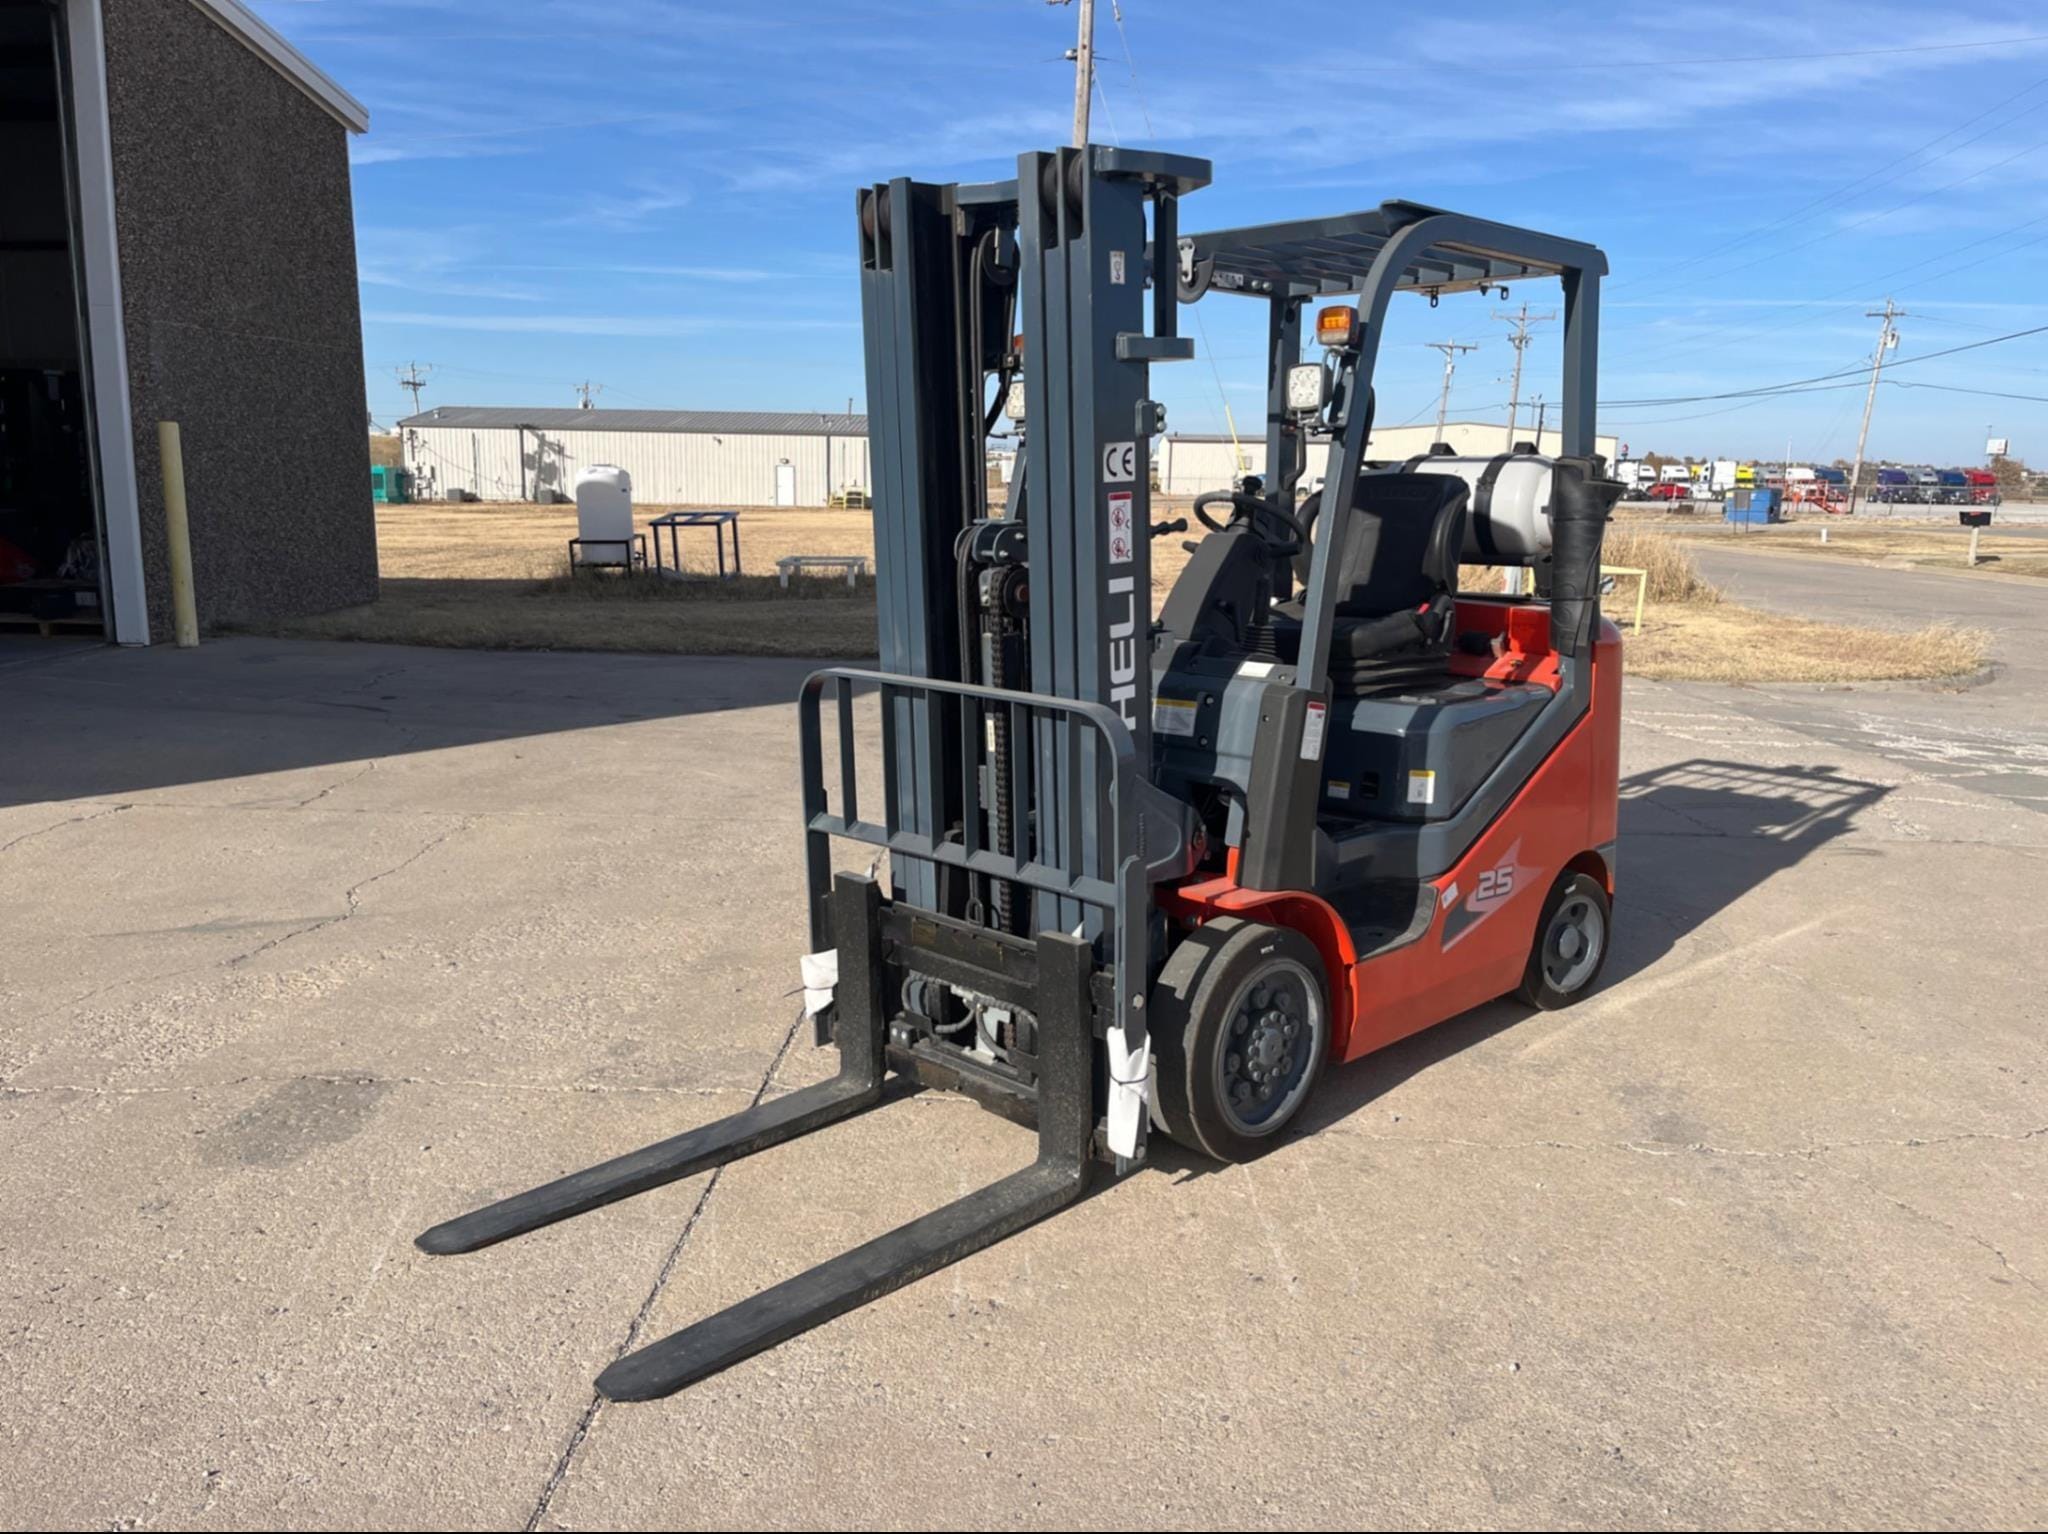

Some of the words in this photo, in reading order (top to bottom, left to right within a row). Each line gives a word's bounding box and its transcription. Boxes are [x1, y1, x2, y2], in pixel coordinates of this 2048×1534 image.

[1106, 446, 1133, 477] CE
[1108, 577, 1136, 731] HELI
[1477, 866, 1514, 900] 25
